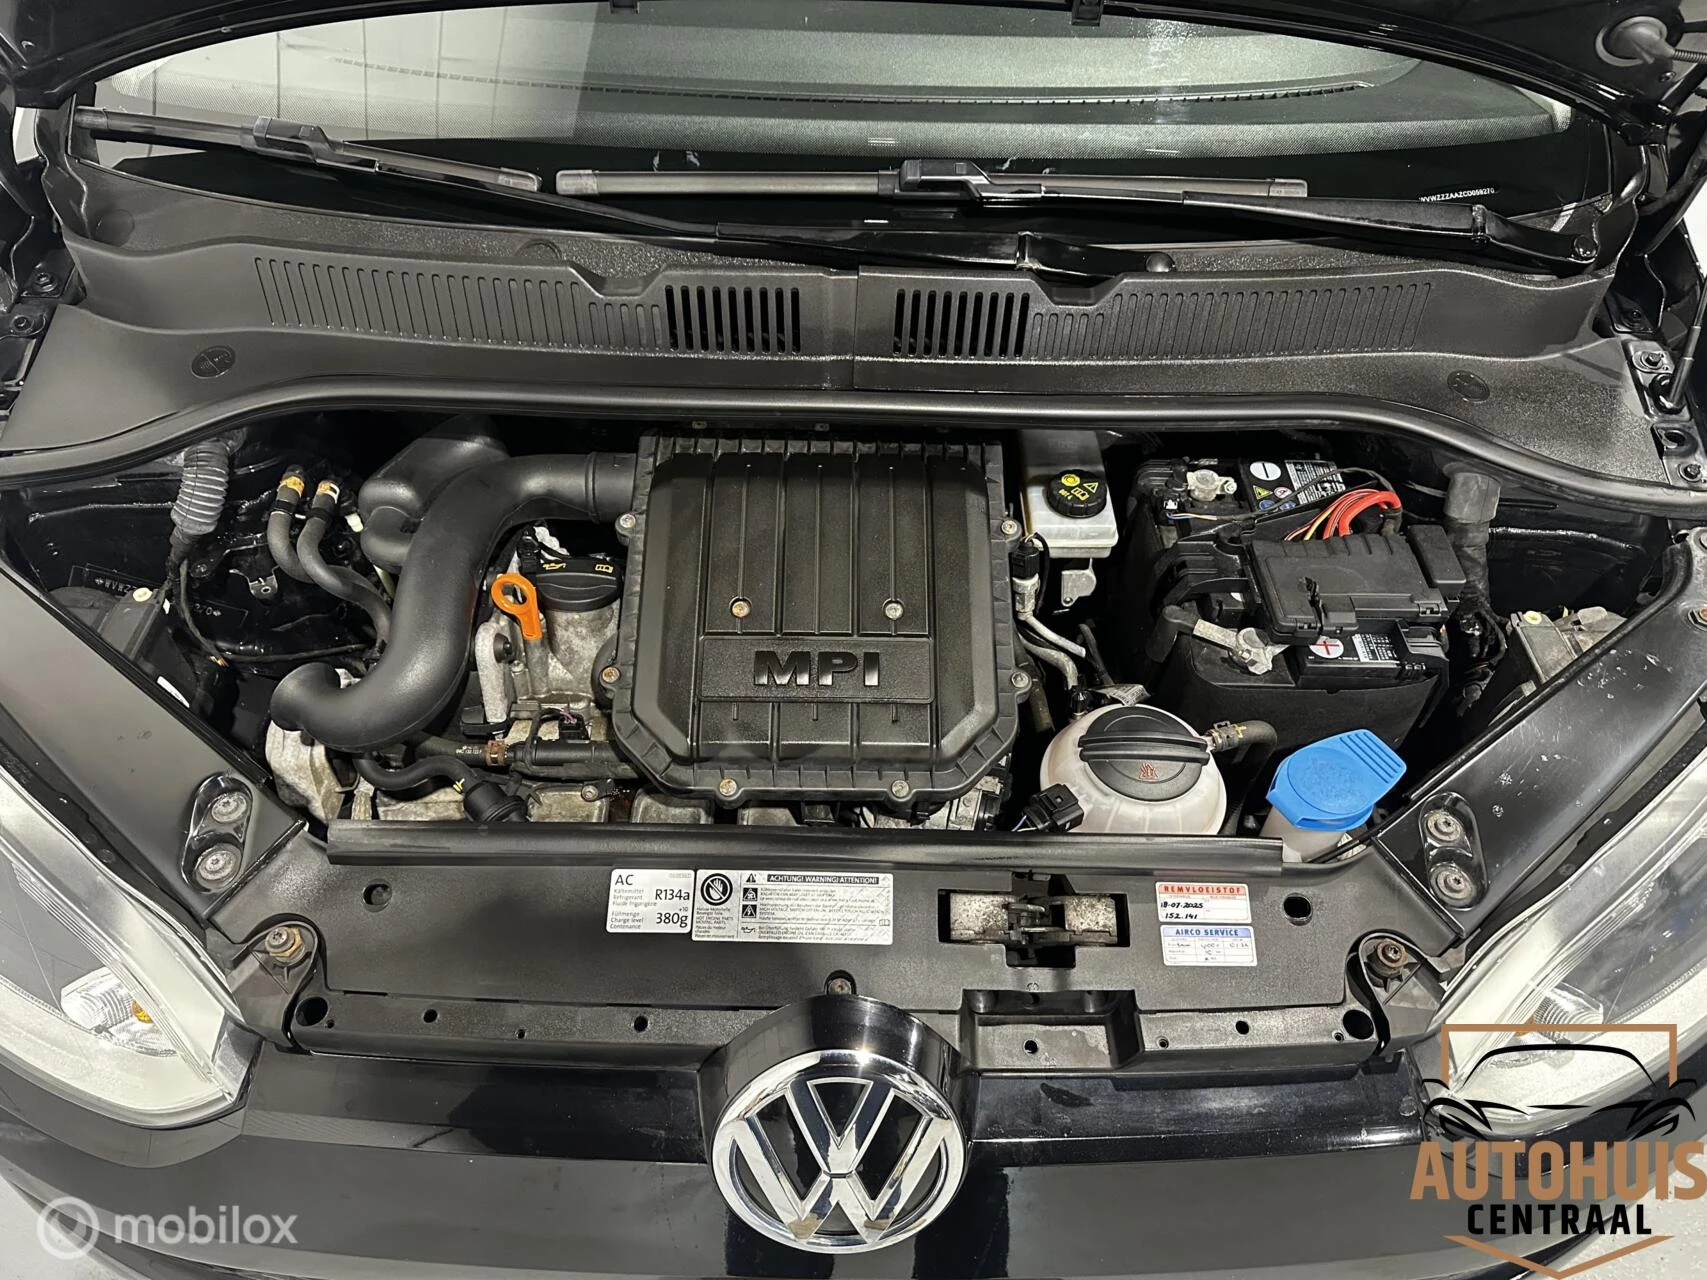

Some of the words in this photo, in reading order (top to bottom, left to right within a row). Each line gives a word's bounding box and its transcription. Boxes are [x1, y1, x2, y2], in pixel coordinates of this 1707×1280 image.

[753, 650, 880, 687] MPI
[614, 874, 634, 886] AC
[769, 874, 804, 882] ACHTUNG!
[805, 875, 839, 884] WARNING!
[655, 888, 690, 901] R134a
[1163, 885, 1241, 894] REMVLOEISTOF
[655, 912, 689, 929] 380g
[1175, 928, 1201, 937] AIRCO
[1204, 928, 1239, 937] SERVICE
